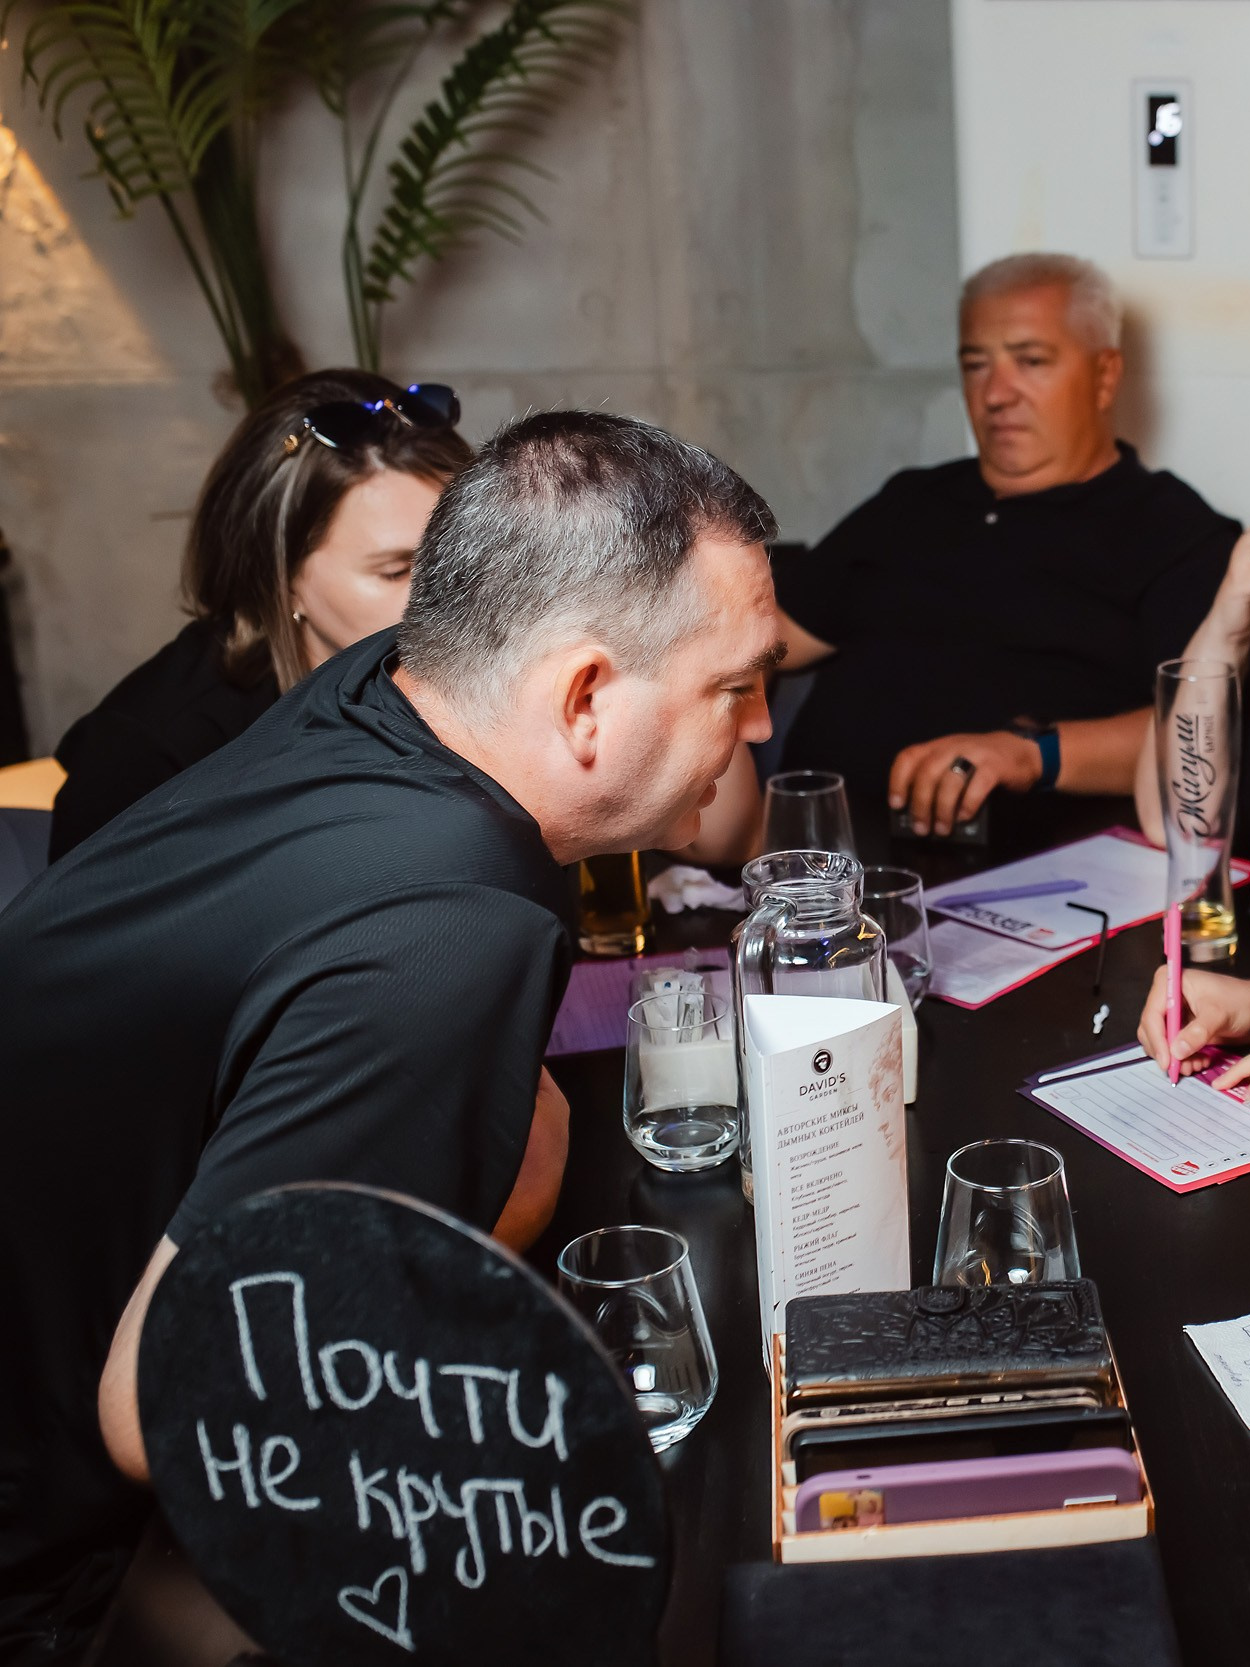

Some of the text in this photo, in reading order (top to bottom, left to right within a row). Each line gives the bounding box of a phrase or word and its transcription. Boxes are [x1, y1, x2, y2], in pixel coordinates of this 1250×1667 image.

[1172, 714, 1217, 838] Жигули
[799, 1072, 846, 1097] DAVID'S
[809, 1088, 838, 1101] GARDEN
[776, 1111, 864, 1150] ДЫМНЫХ КОКТЕЙЛЕЙ
[777, 1103, 858, 1138] АВТОРСКИЕ МИКСЫ
[789, 1141, 839, 1164] ВОЗРОЖДЕНИЕ
[806, 1170, 843, 1189] ВКЛЮЧЕНО
[229, 1270, 569, 1462] Почти
[348, 1449, 657, 1590] крутые
